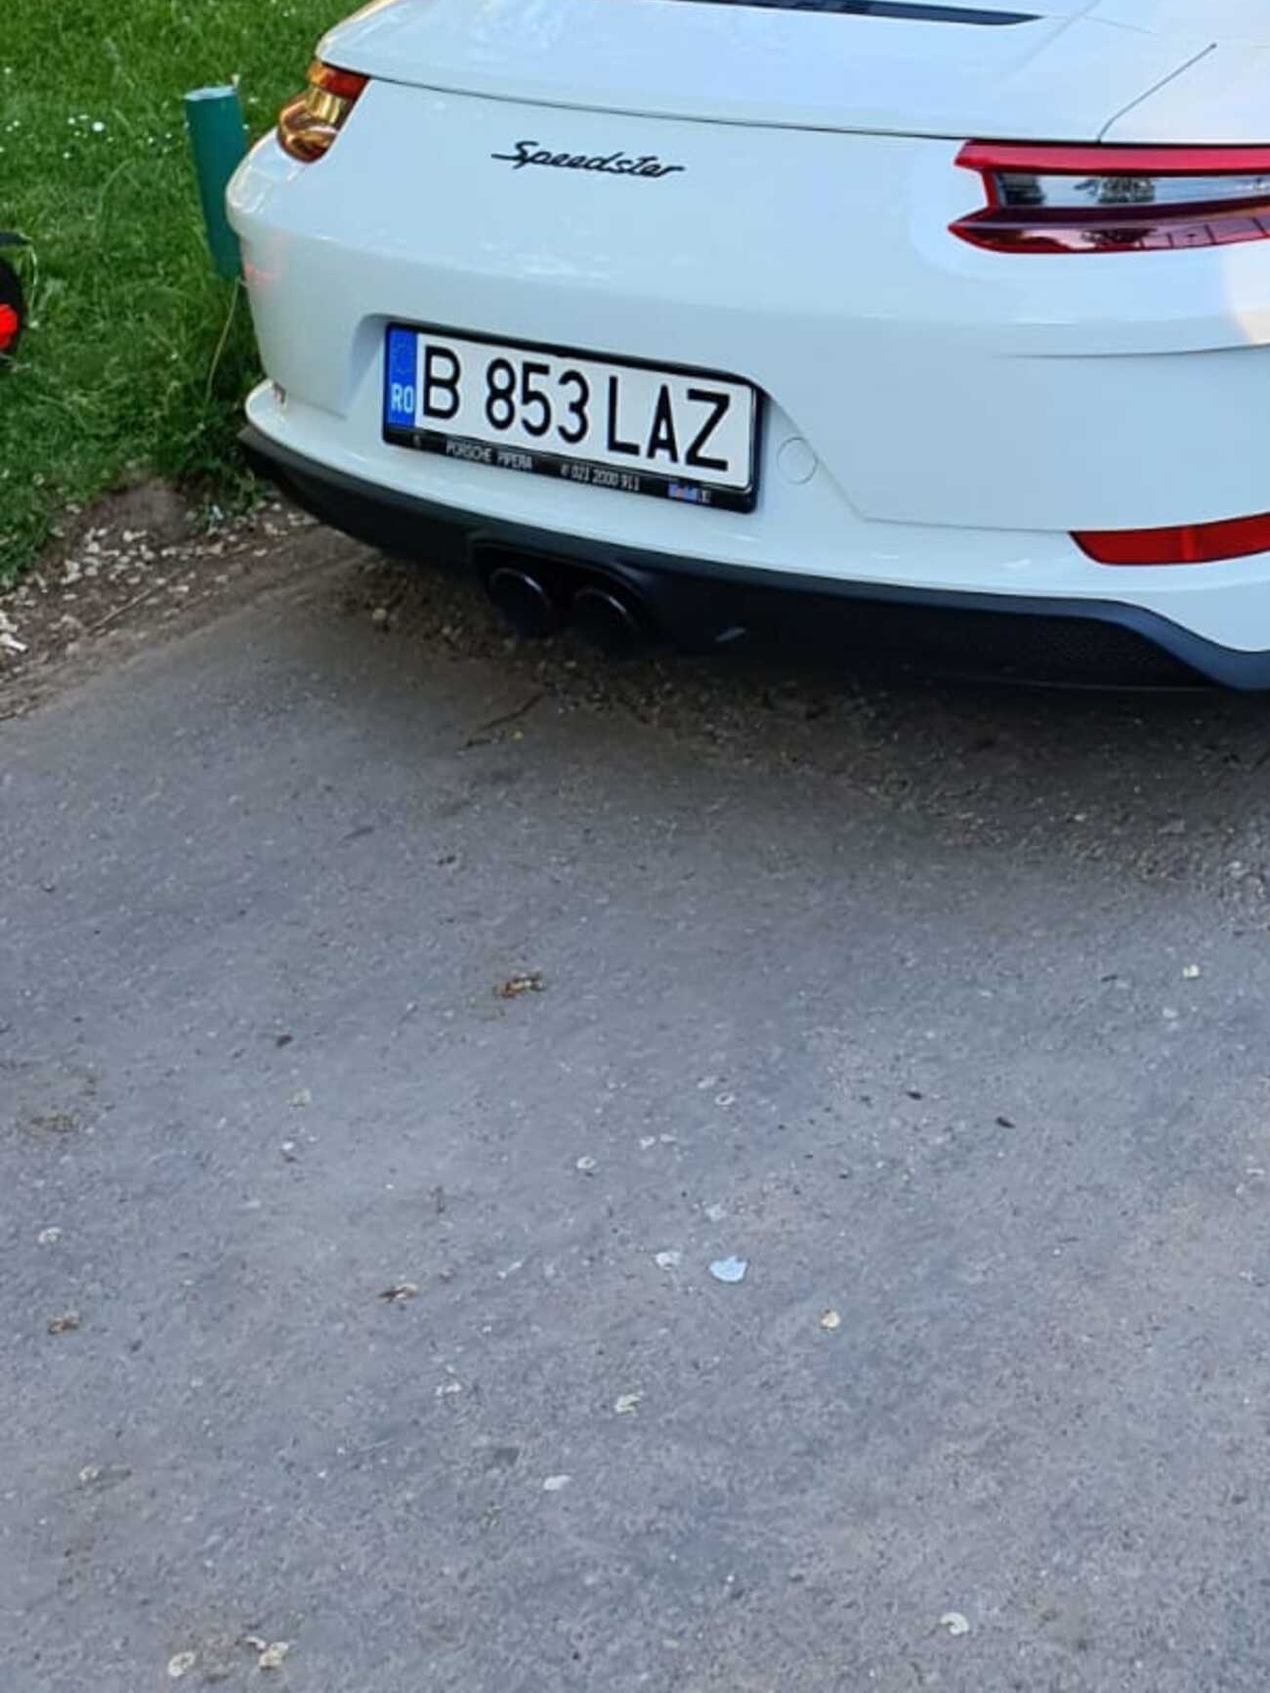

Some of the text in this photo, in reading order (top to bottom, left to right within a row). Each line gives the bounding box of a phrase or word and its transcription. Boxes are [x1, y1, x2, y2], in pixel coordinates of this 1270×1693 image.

[490, 140, 686, 178] Speedster
[390, 382, 415, 414] RO
[422, 344, 732, 472] B 853 LAZ
[445, 439, 493, 463] PORSCHE
